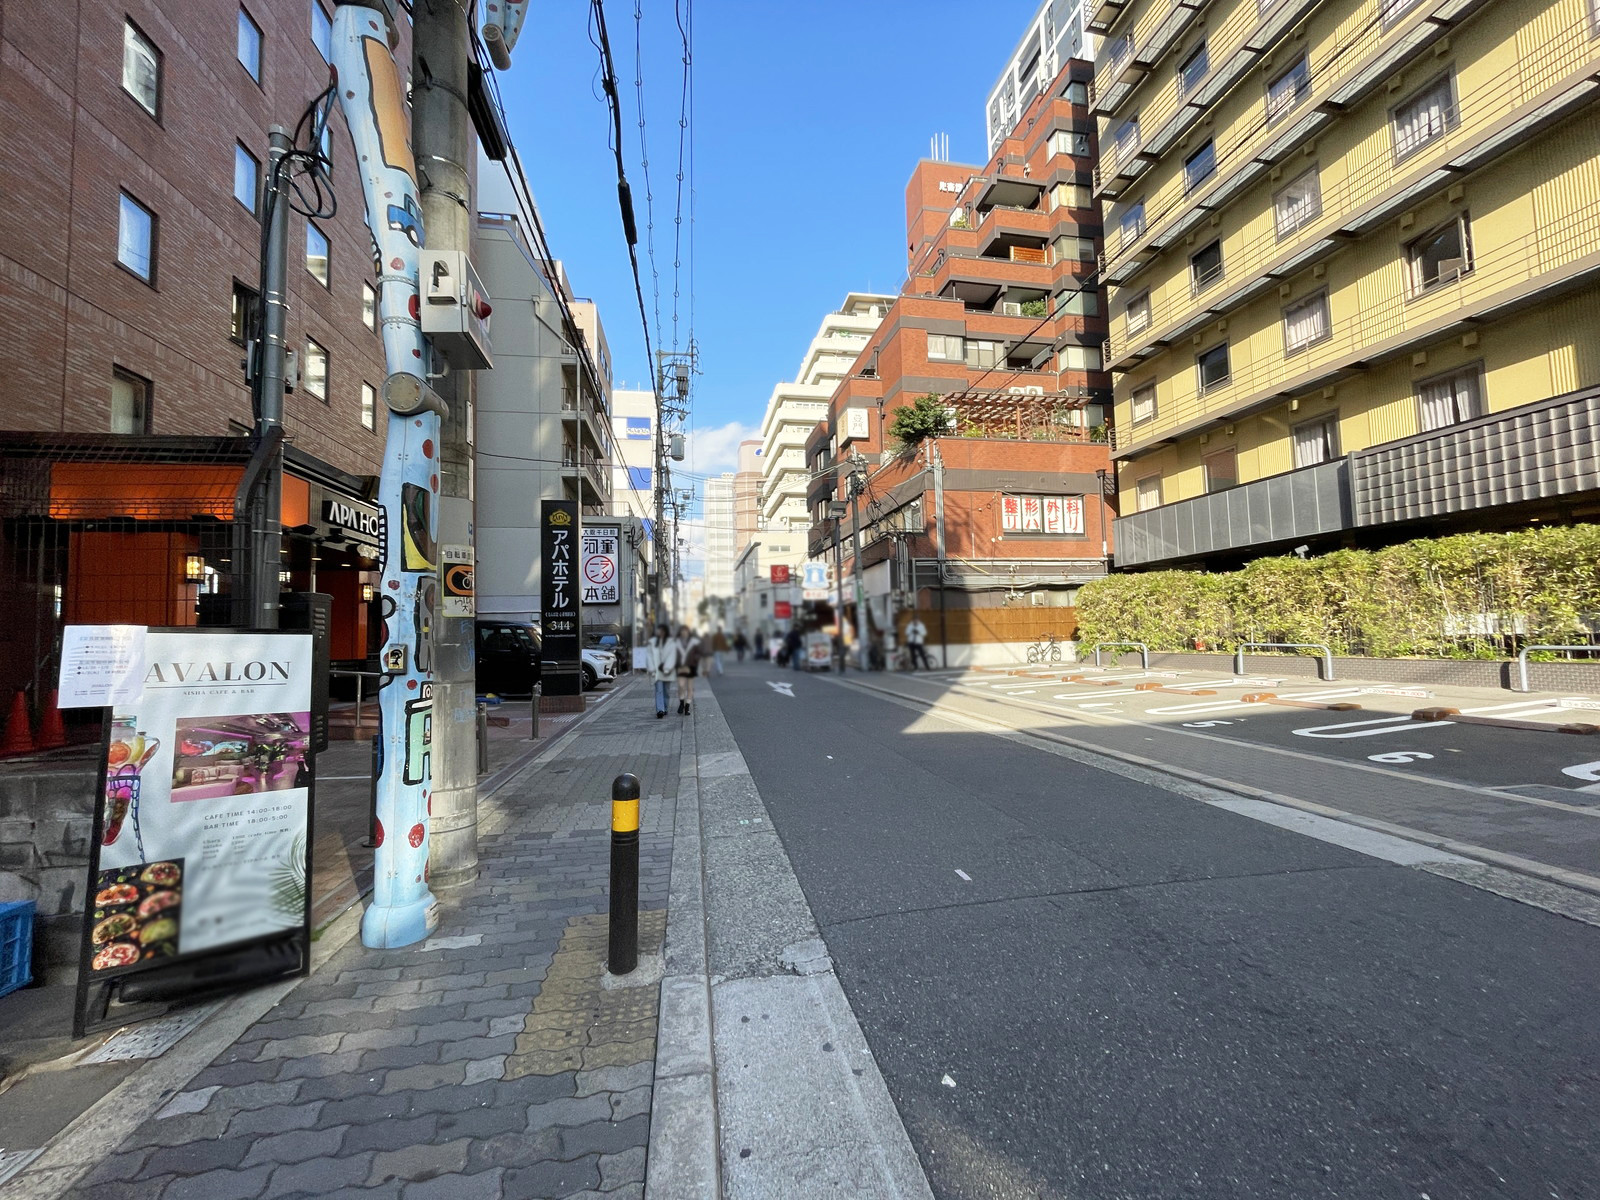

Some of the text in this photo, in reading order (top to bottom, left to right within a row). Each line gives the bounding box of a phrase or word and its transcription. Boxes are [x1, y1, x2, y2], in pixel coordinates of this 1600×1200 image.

[329, 501, 358, 529] APA
[1004, 497, 1080, 517] 整形外科
[1007, 515, 1079, 533] リハビリ
[584, 538, 615, 554] 河童
[551, 530, 570, 608] アパホテル
[584, 585, 616, 601] 本舗
[551, 620, 571, 631] 344
[143, 661, 291, 683] AVALON
[1367, 751, 1434, 763] 6
[204, 804, 292, 821] CAFE TIME 14:00-18:00
[221, 820, 239, 828] TIME
[247, 813, 288, 825] 18:00-5:00
